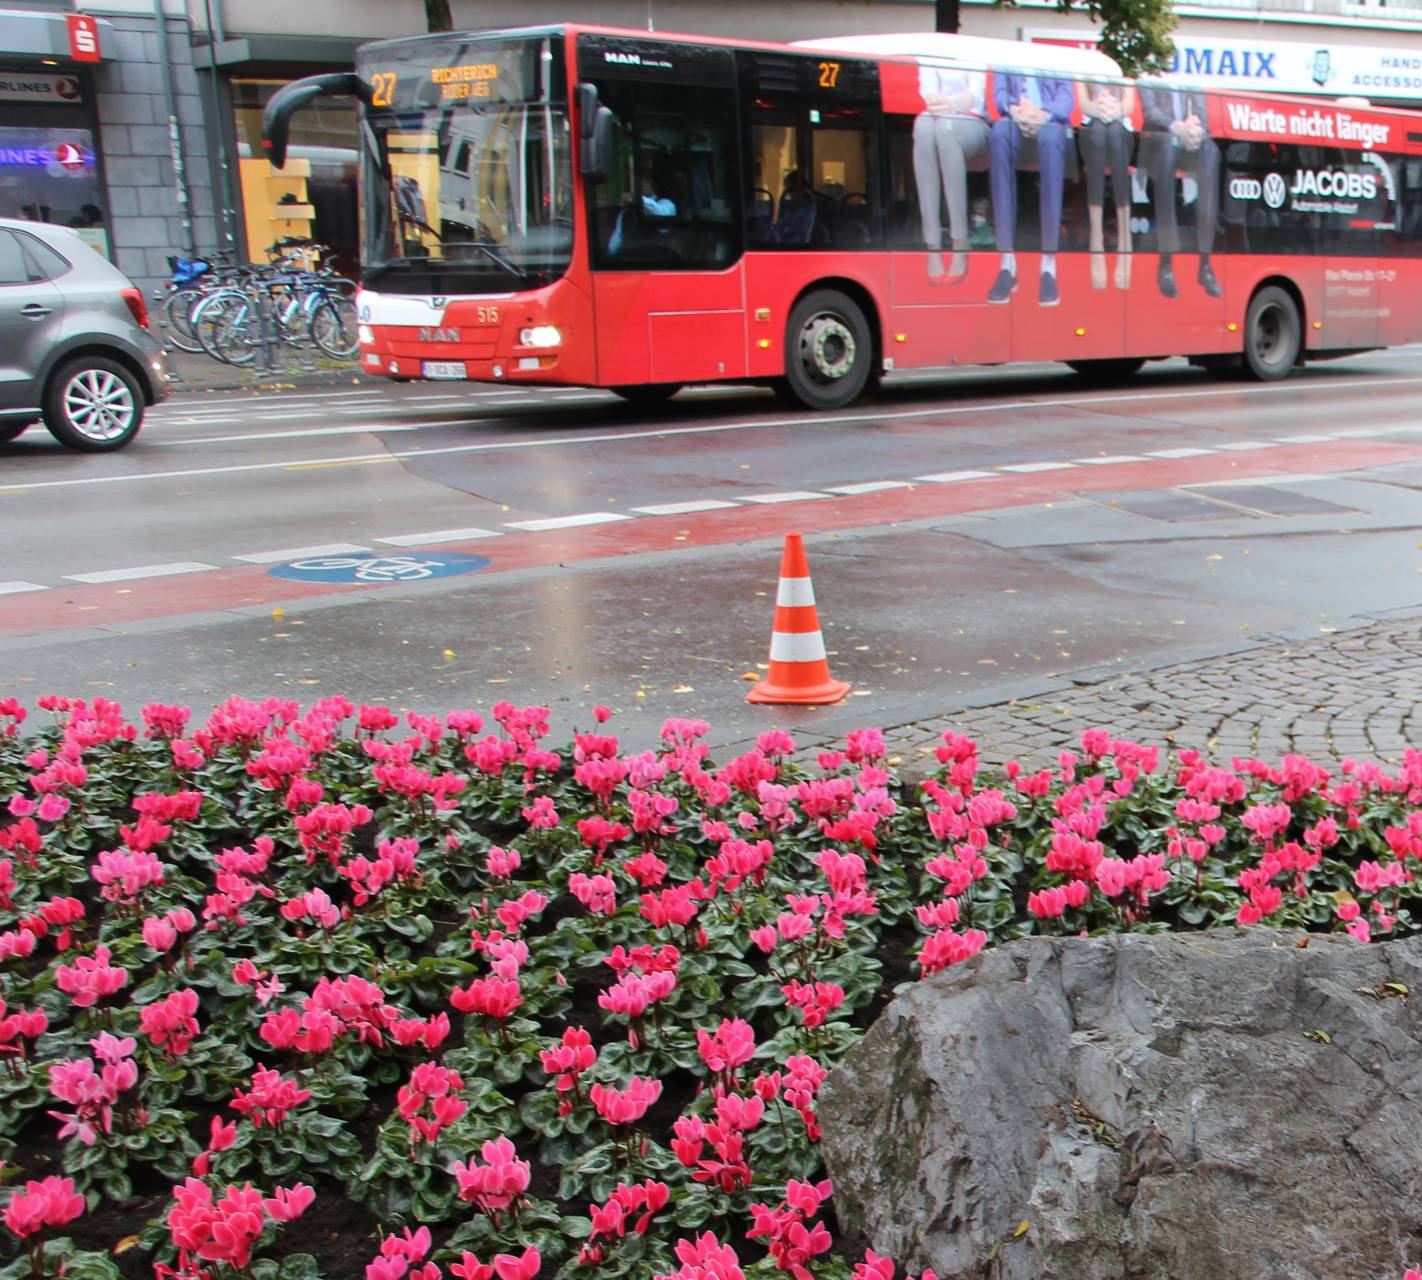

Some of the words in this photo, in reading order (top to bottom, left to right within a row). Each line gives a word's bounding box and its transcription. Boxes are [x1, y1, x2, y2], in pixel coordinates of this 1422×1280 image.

[818, 62, 840, 87] 27
[371, 72, 398, 106] 27
[1228, 103, 1287, 134] Warte
[1290, 109, 1335, 139] nicht
[1336, 112, 1390, 149] länger
[1291, 170, 1377, 199] JACOBS
[477, 306, 499, 323] 515
[419, 327, 461, 342] MAN
